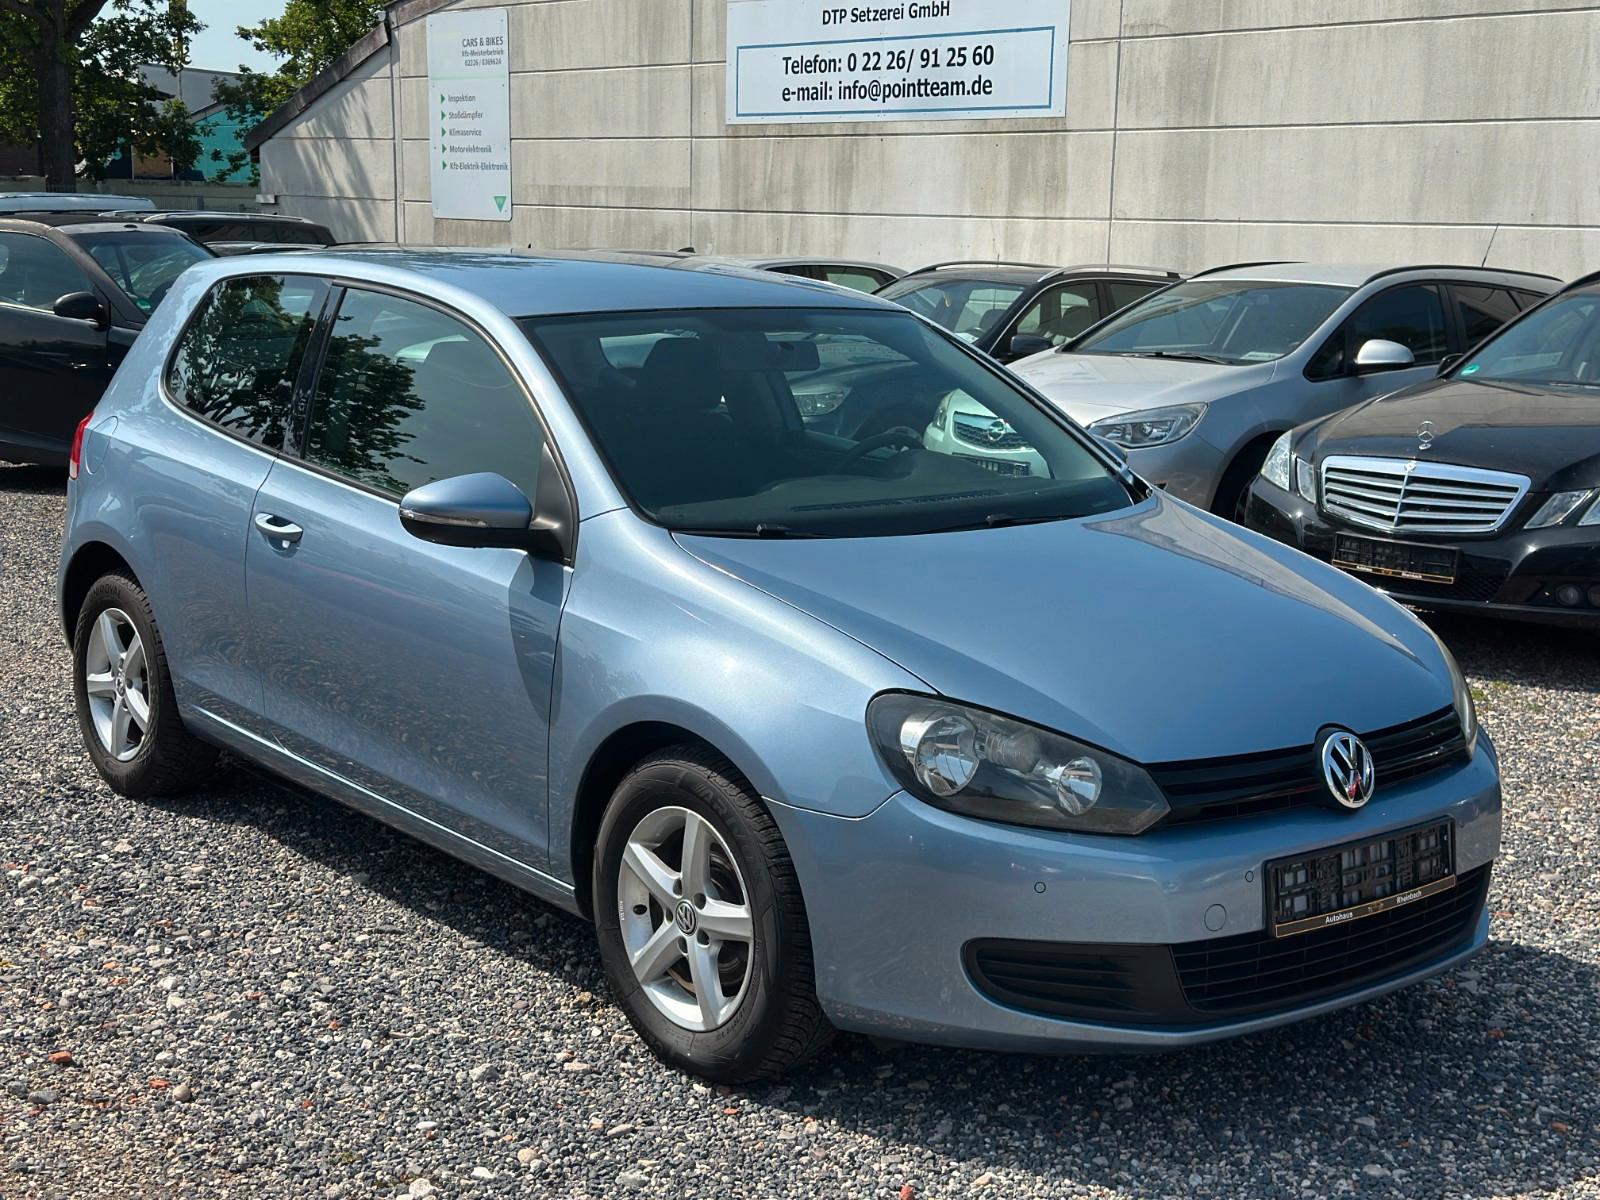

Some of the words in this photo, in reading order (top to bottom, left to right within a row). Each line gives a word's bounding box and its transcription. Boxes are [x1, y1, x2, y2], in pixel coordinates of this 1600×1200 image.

[822, 8, 847, 25] DTP
[850, 3, 904, 23] Setzerei
[908, 1, 950, 19] GmbH
[462, 38, 478, 47] CARS
[480, 37, 484, 46] &
[486, 36, 503, 46] BIKES
[782, 54, 842, 75] Telefon:
[847, 53, 857, 72] 0
[862, 51, 881, 71] 22
[920, 48, 940, 69] 91
[946, 46, 967, 67] 25
[972, 44, 994, 66] 60
[782, 80, 833, 102] e-mail:
[838, 74, 993, 103] info@pointteam.de
[447, 92, 476, 104] Inspektion
[448, 110, 483, 121] Stoßdämpfer
[449, 127, 482, 137] Klimaservice
[449, 145, 492, 154] Motorelektronik
[1323, 733, 1373, 807] VW
[1325, 910, 1353, 924] Autohaus
[1396, 889, 1422, 904] Rheinbach
